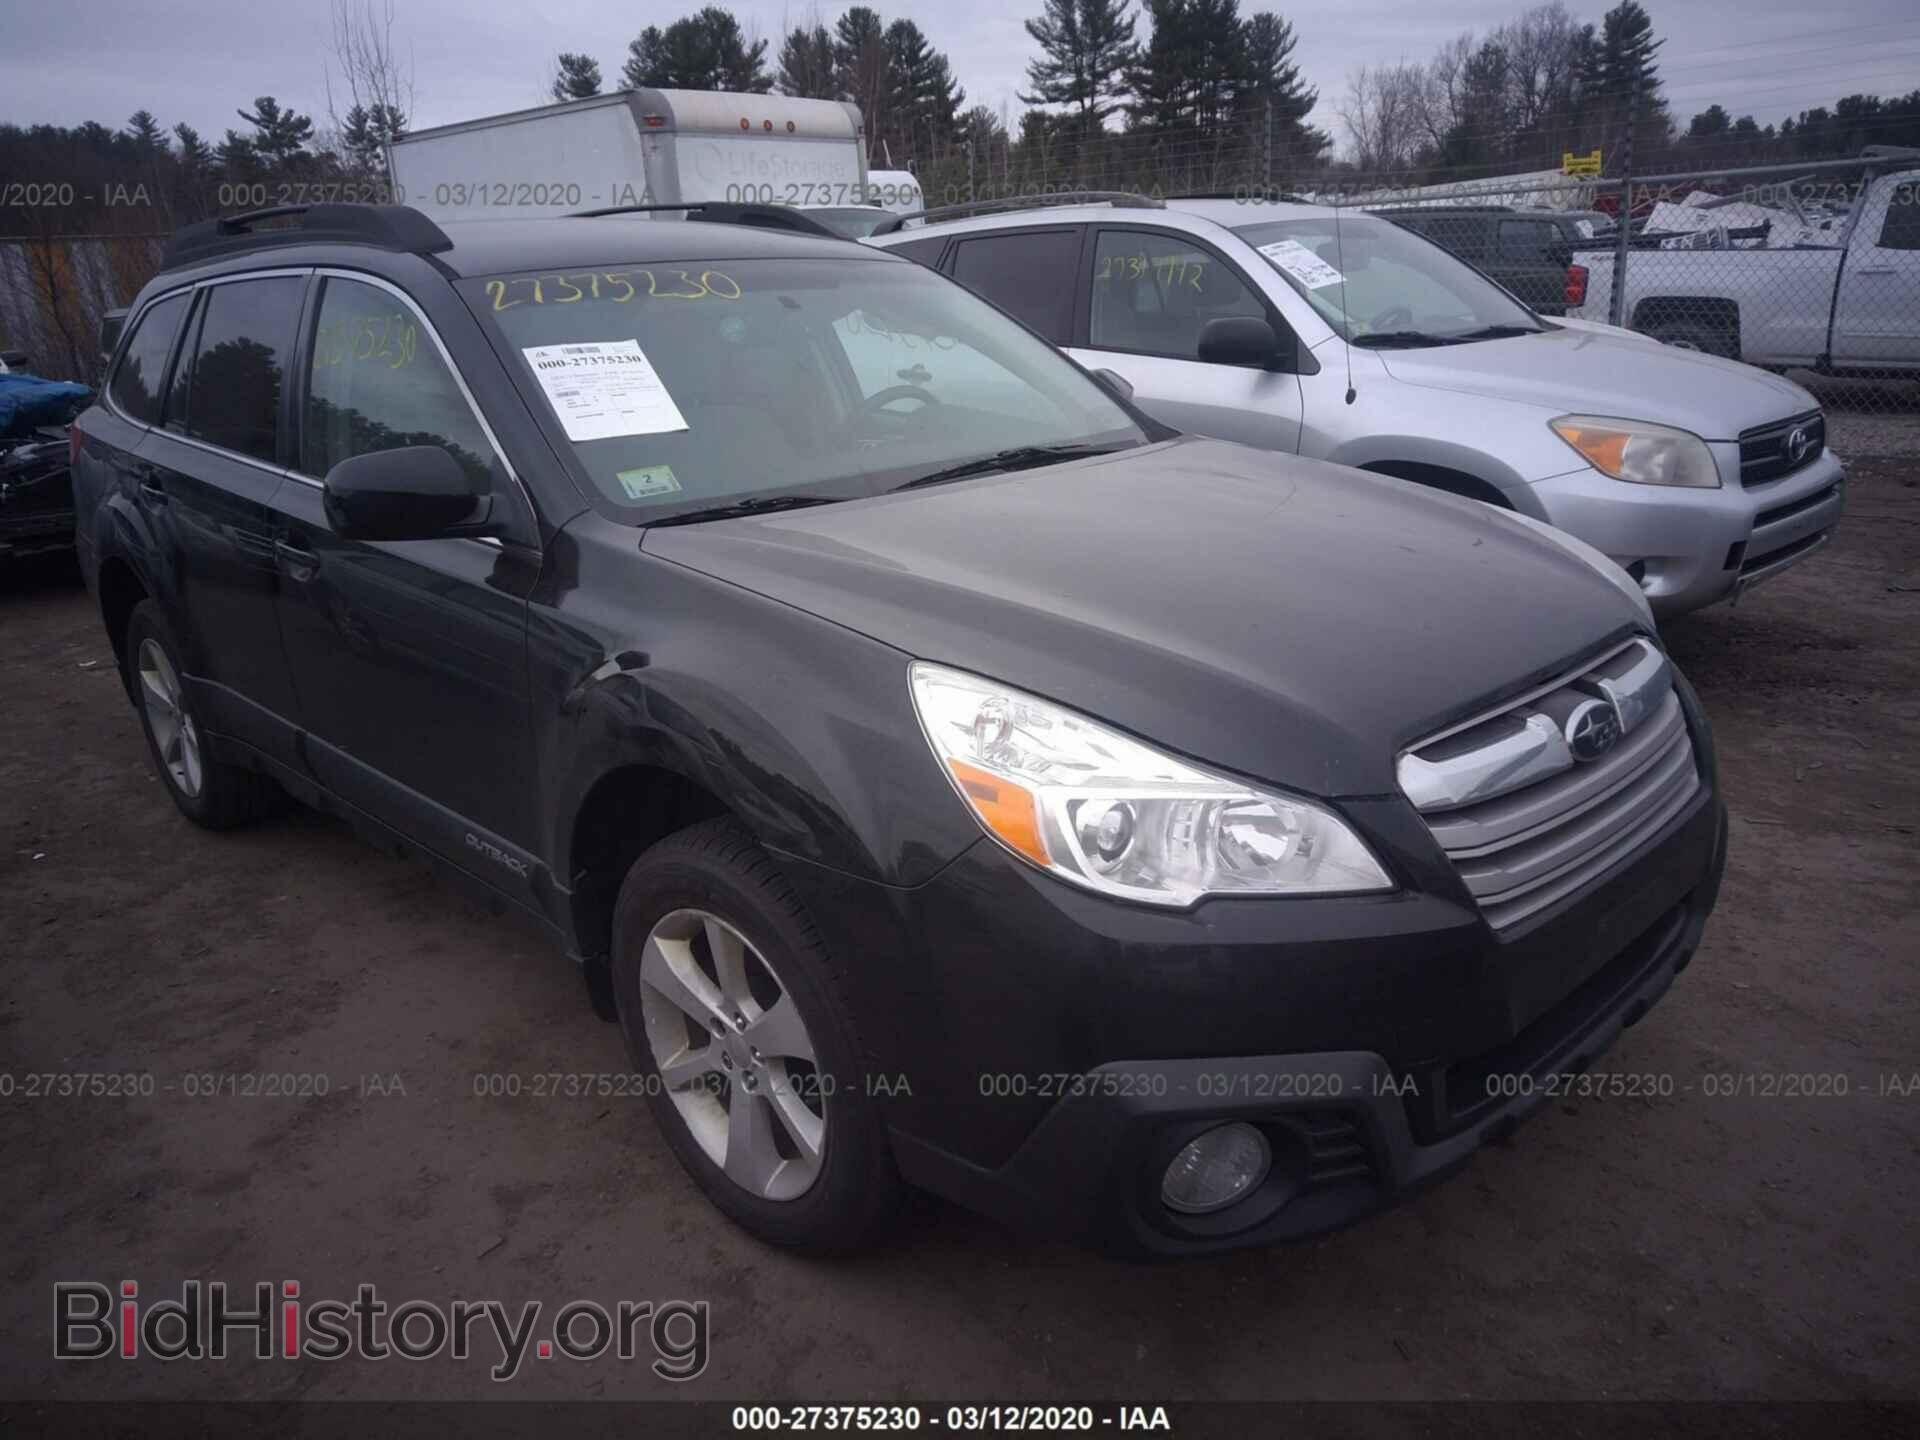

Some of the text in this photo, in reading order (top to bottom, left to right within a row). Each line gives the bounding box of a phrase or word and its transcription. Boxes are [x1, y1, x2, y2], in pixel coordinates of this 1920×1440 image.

[486, 270, 741, 311] 27375230
[537, 354, 642, 371] 000-27375230
[642, 473, 654, 484] 2
[464, 832, 528, 879] OUTBACK
